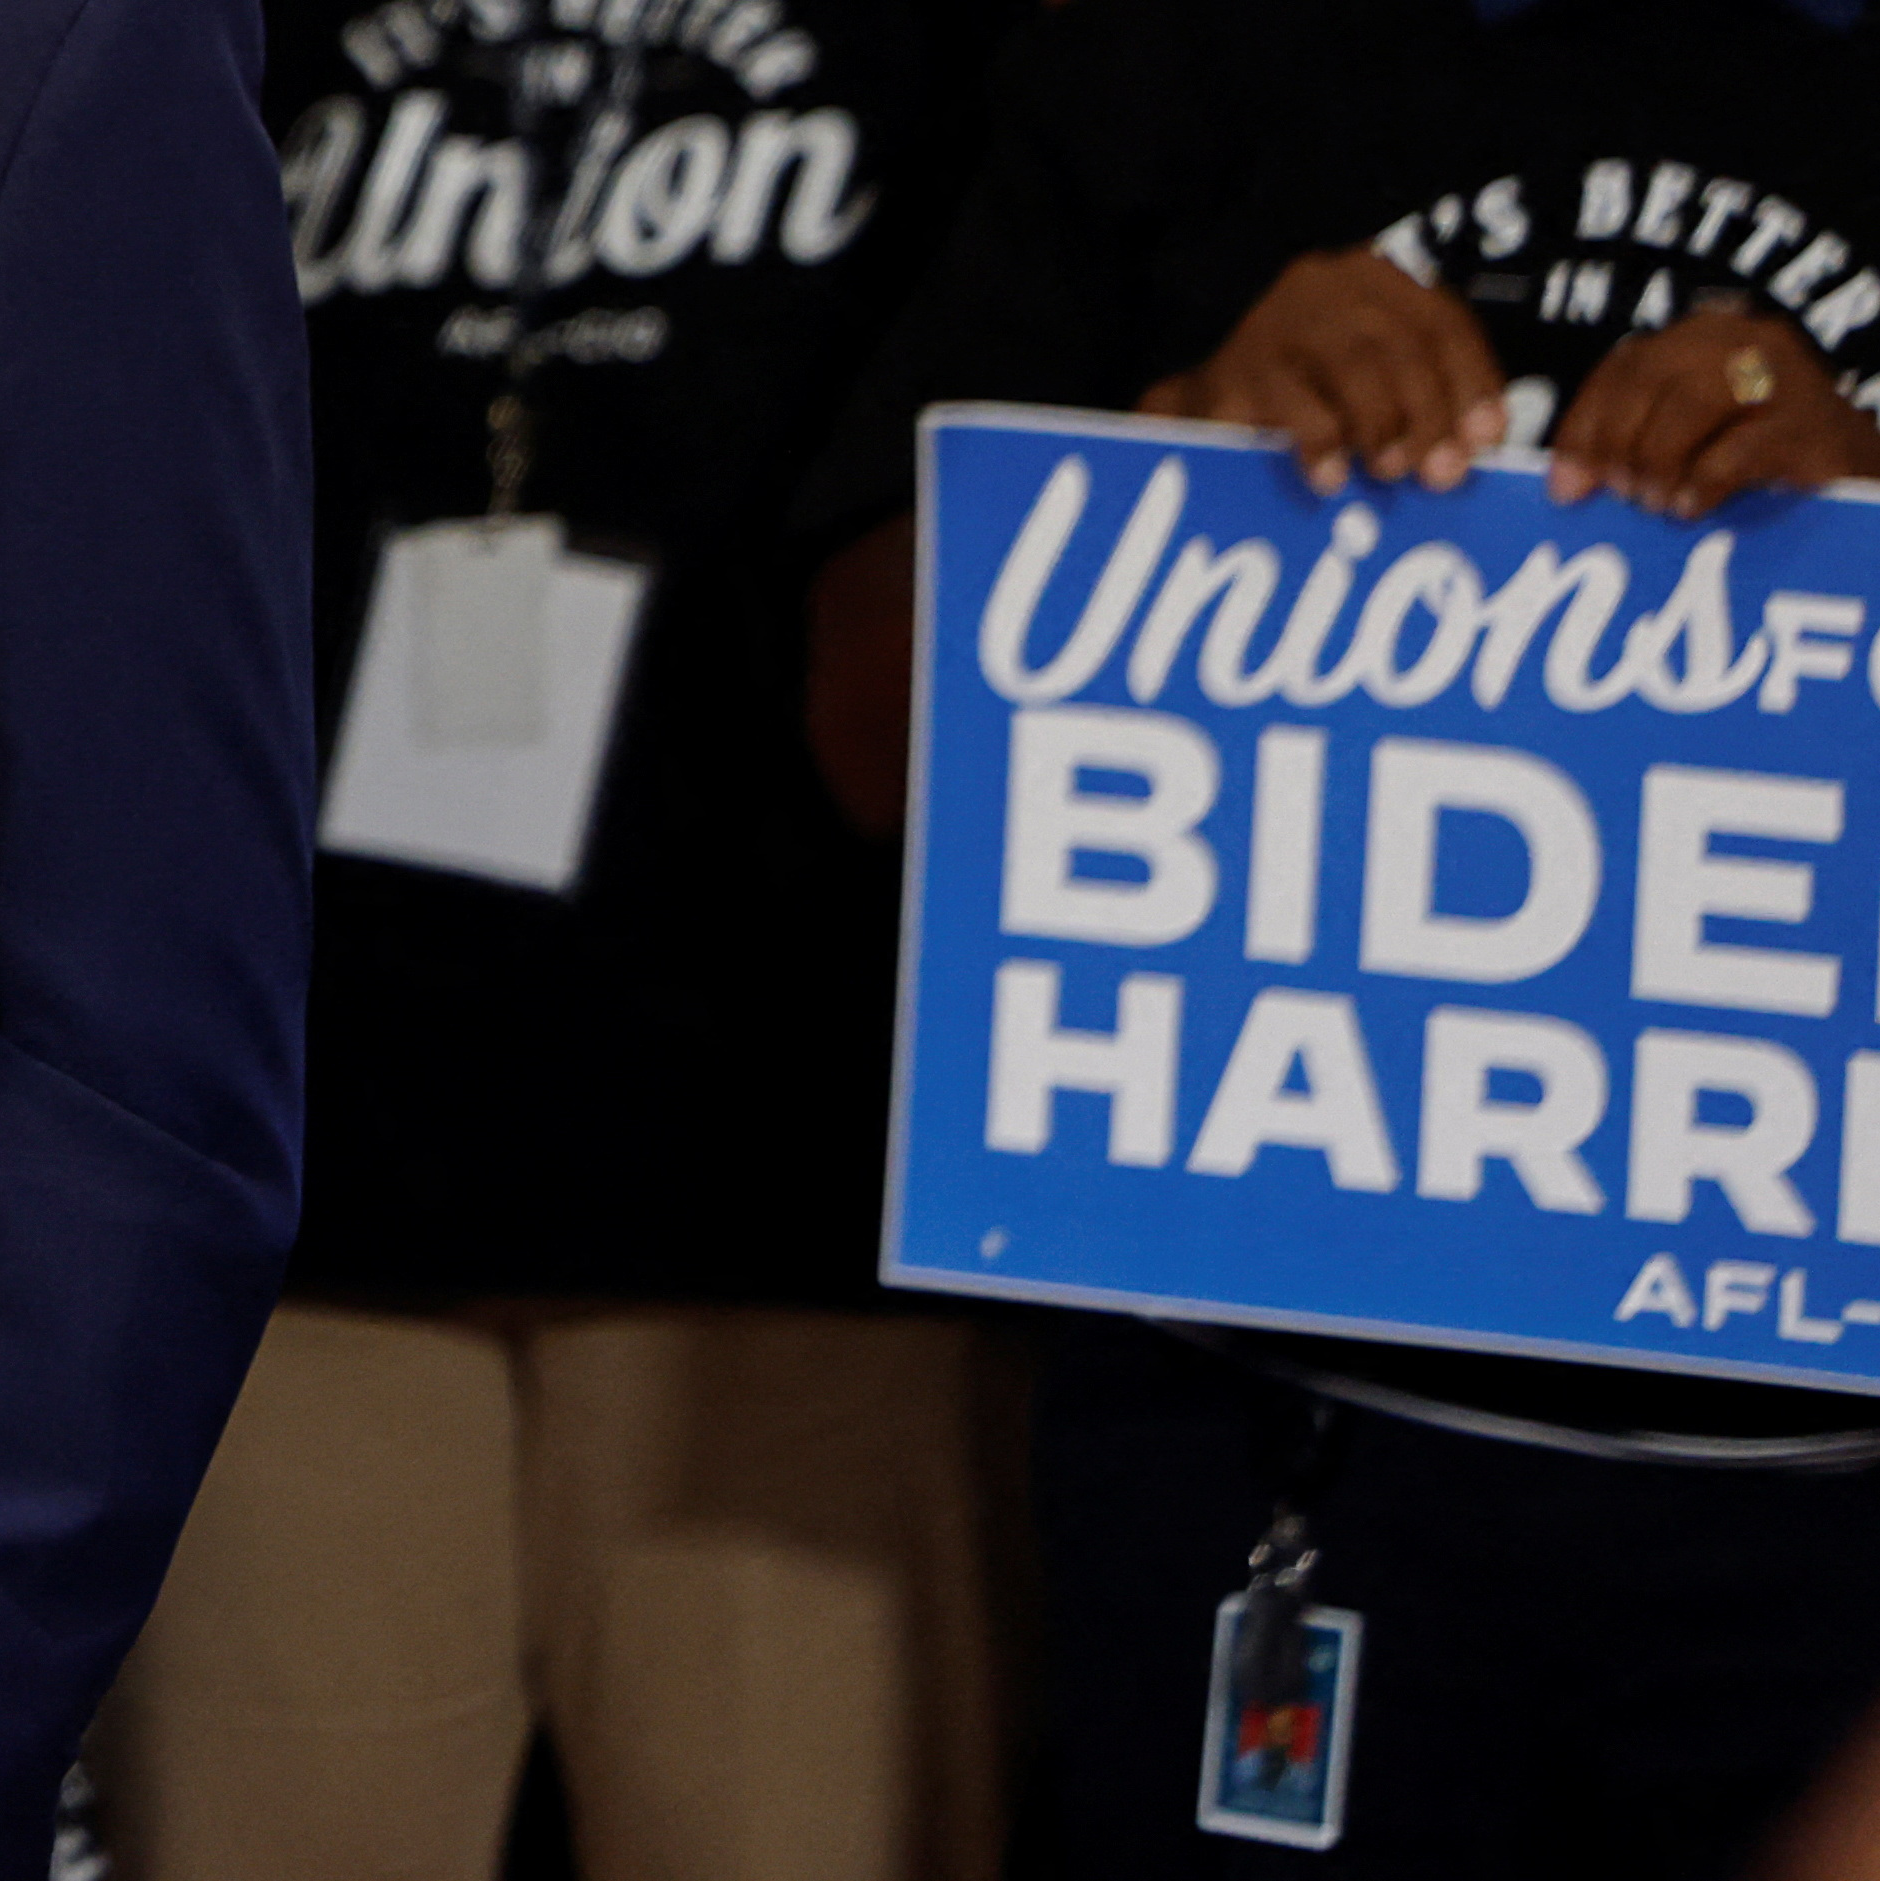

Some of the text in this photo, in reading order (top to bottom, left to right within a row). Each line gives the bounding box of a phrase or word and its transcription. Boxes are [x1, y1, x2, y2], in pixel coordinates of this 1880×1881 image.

[1541, 259, 1675, 331] IN A
[977, 453, 1776, 714] Unions
